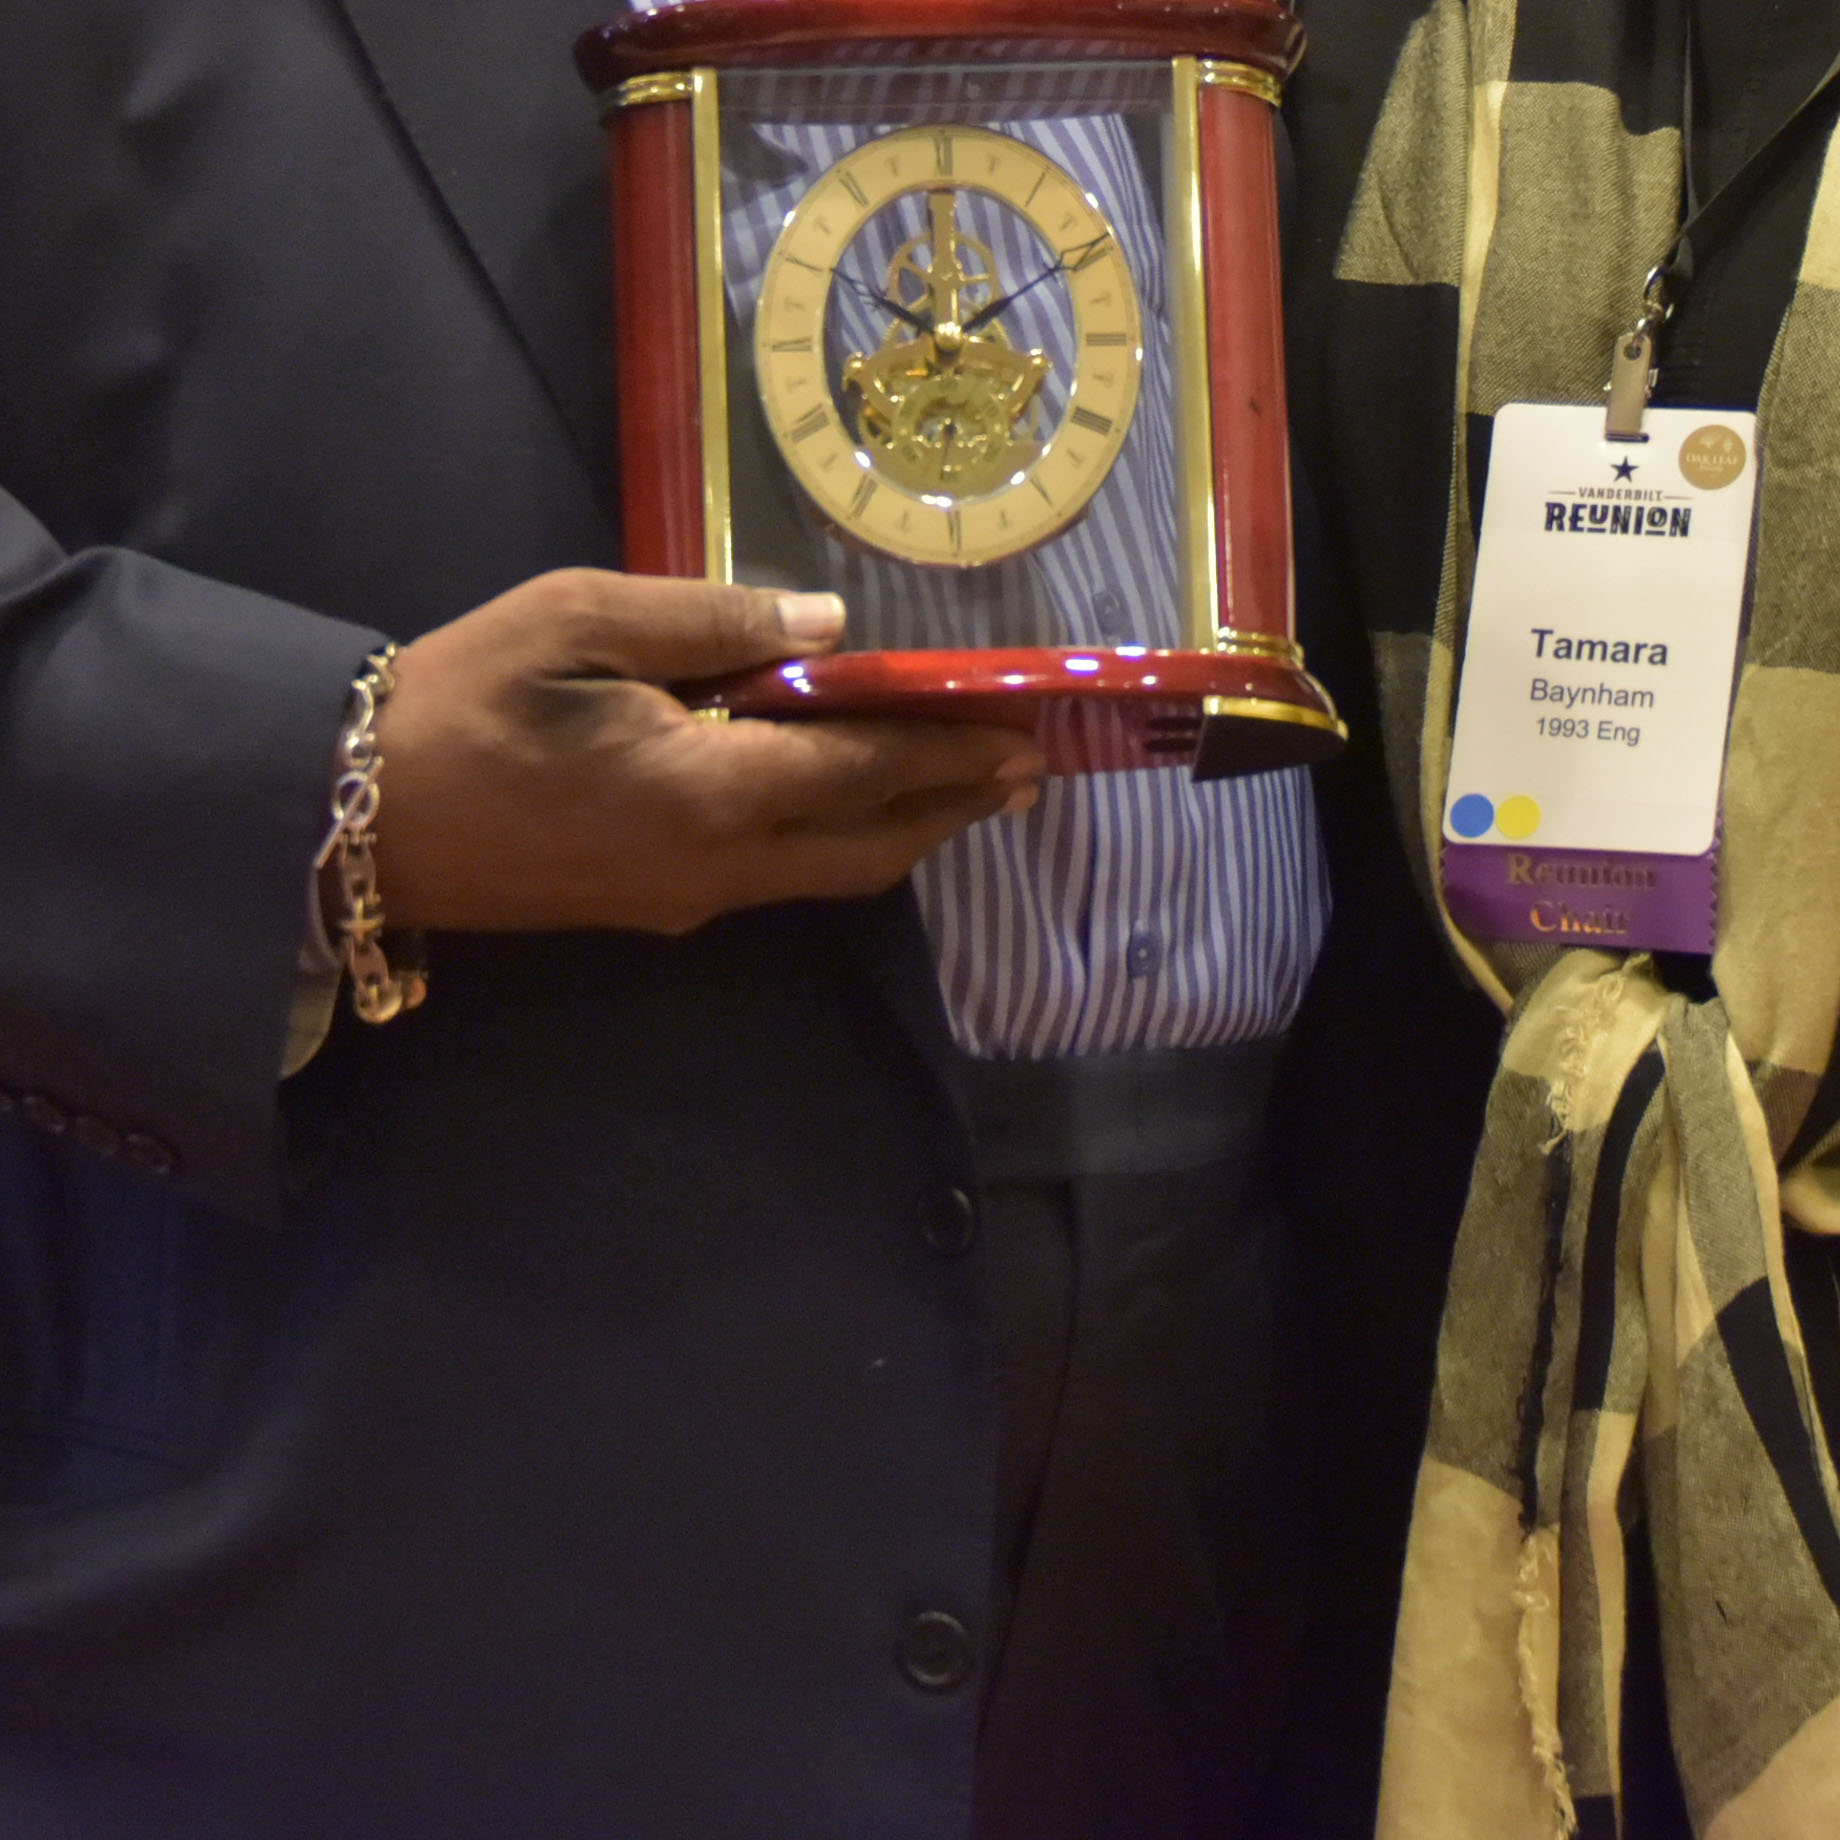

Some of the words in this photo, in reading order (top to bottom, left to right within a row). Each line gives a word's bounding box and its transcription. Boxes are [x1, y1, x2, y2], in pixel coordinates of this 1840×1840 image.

[1578, 487, 1663, 501] VANDERBILT
[1544, 502, 1692, 537] REUNION
[1531, 628, 1668, 666] Tamara
[1530, 678, 1655, 709] Baynham
[1537, 717, 1590, 739] 1993
[1597, 720, 1641, 747] Eng
[1508, 853, 1656, 891] Reunion
[1530, 900, 1630, 934] Chair
